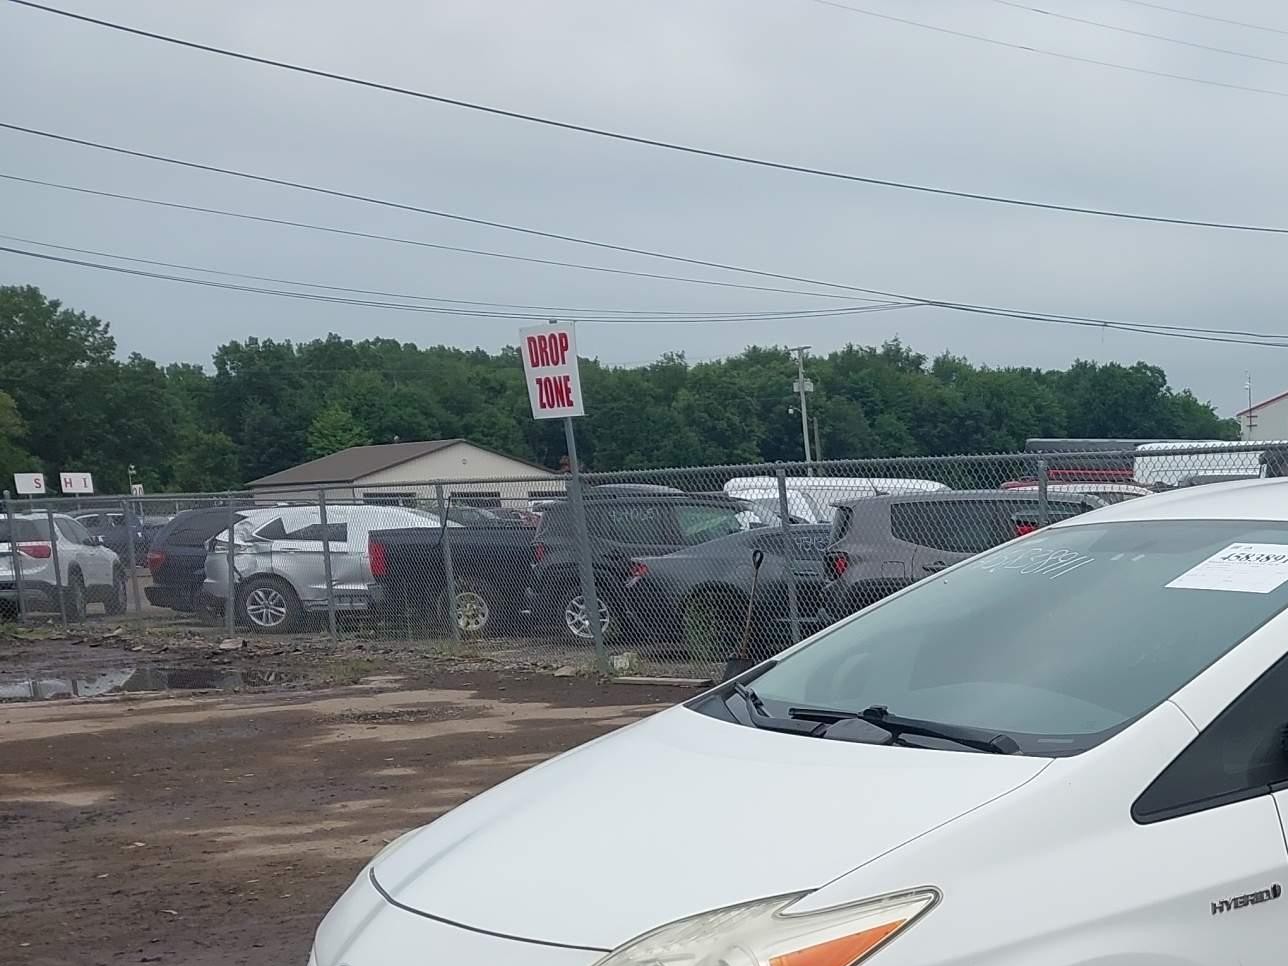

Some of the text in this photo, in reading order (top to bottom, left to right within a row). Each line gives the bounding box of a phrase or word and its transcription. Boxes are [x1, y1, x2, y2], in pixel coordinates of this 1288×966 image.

[527, 332, 569, 368] DROP
[535, 375, 574, 409] ZONE
[33, 478, 42, 489] S
[64, 477, 88, 488] H I
[976, 548, 1095, 580] 5838911
[1210, 889, 1271, 915] HYBRID
